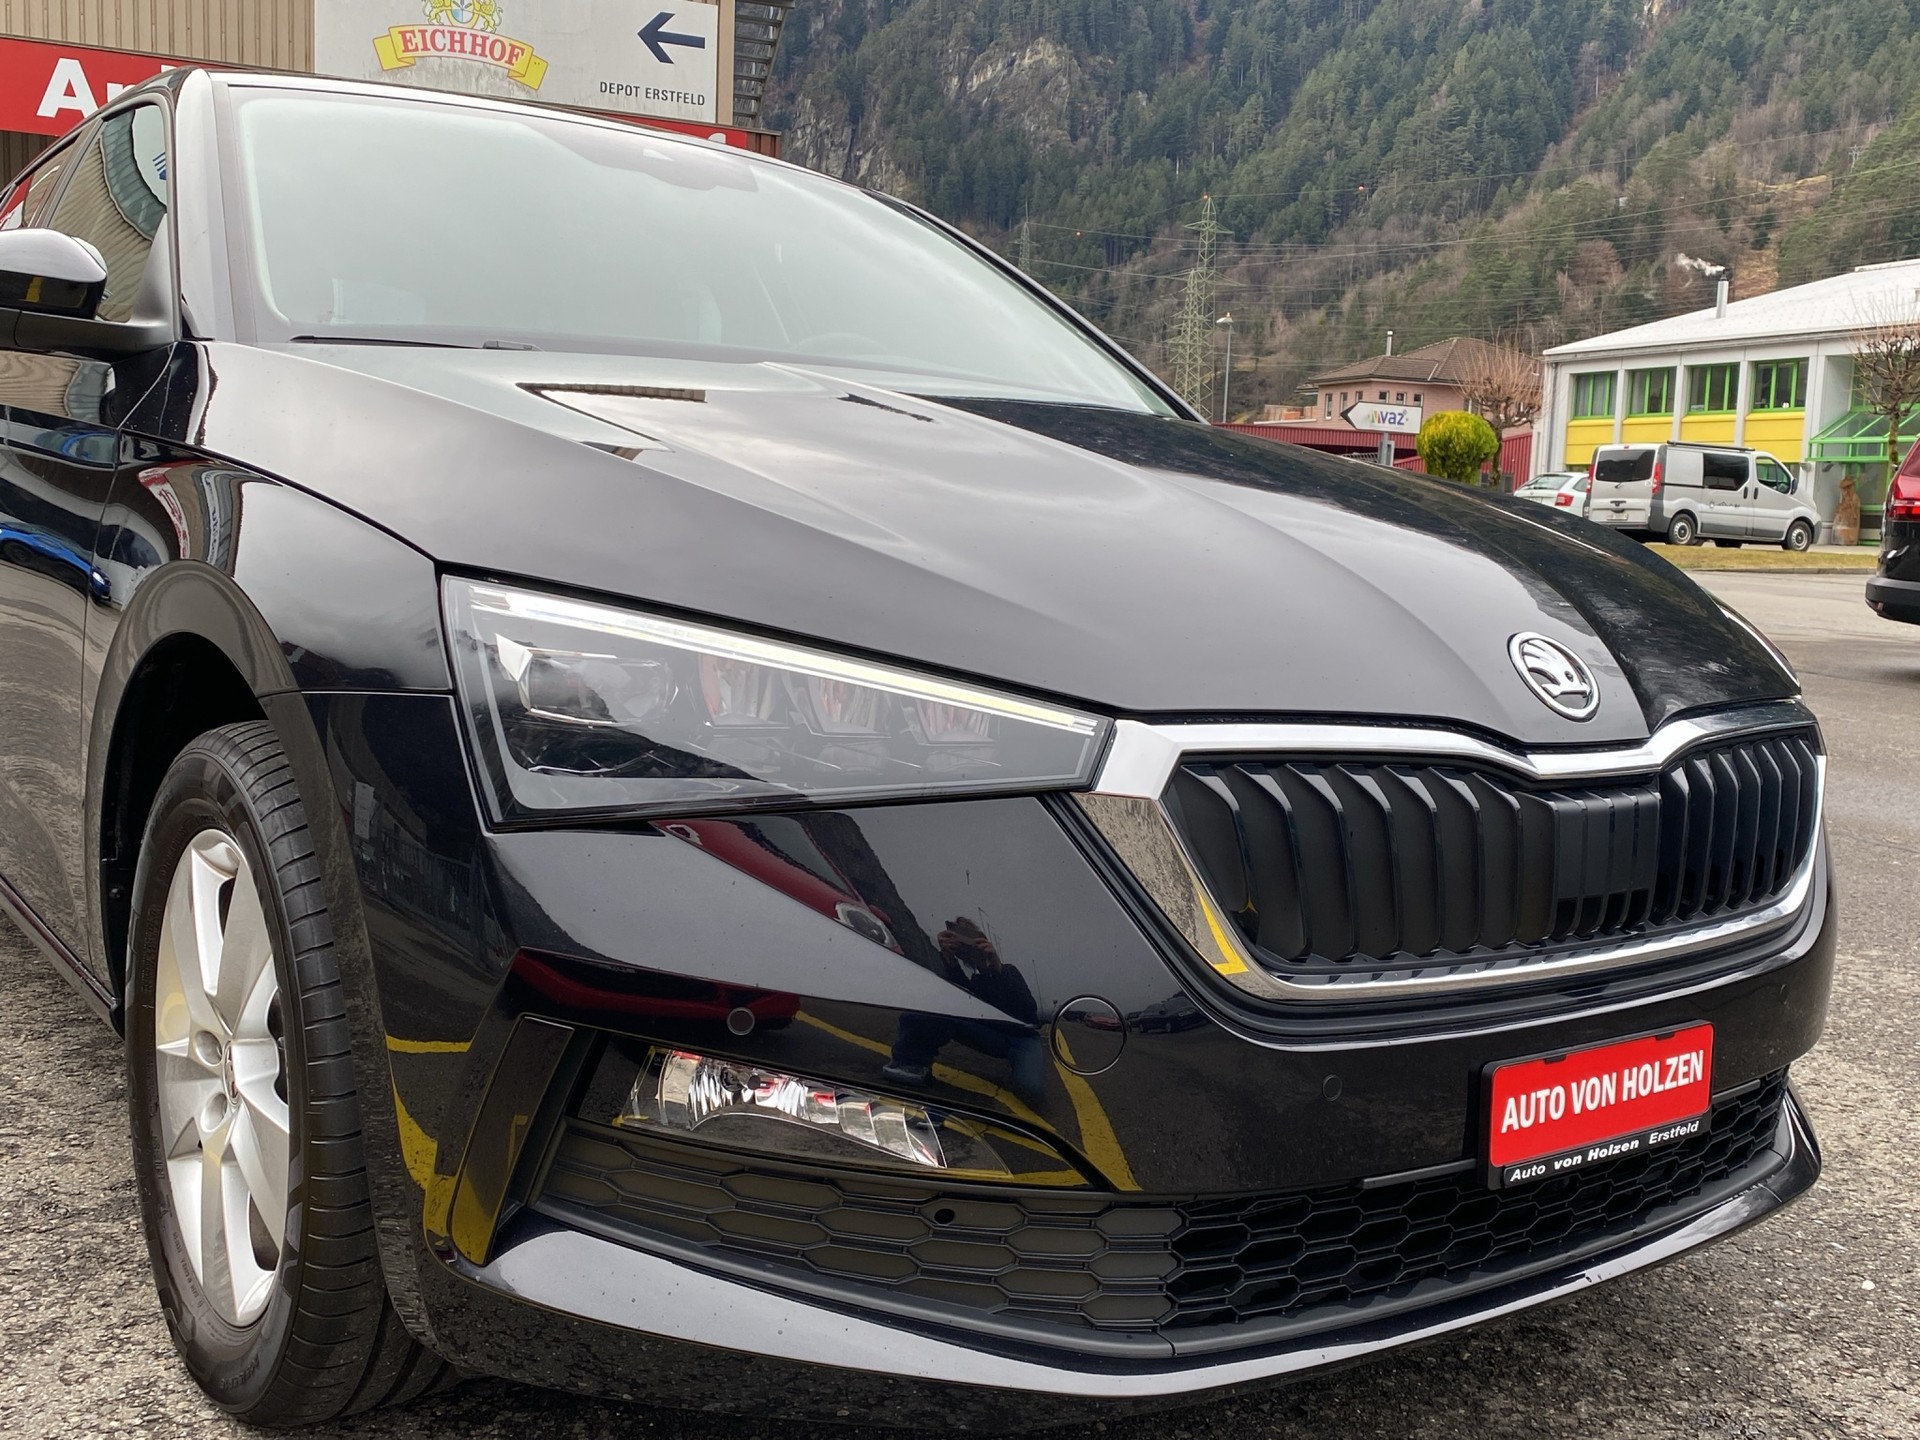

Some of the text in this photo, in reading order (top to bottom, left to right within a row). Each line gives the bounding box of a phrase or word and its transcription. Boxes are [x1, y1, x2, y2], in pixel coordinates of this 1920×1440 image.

[398, 29, 526, 66] EICHHOF
[599, 81, 706, 107] DEPOT ERSTFELD
[1500, 1050, 1704, 1134] AUTO VON HOLZEN
[1510, 1121, 1700, 1182] Auto von Holzen Erstfeld
